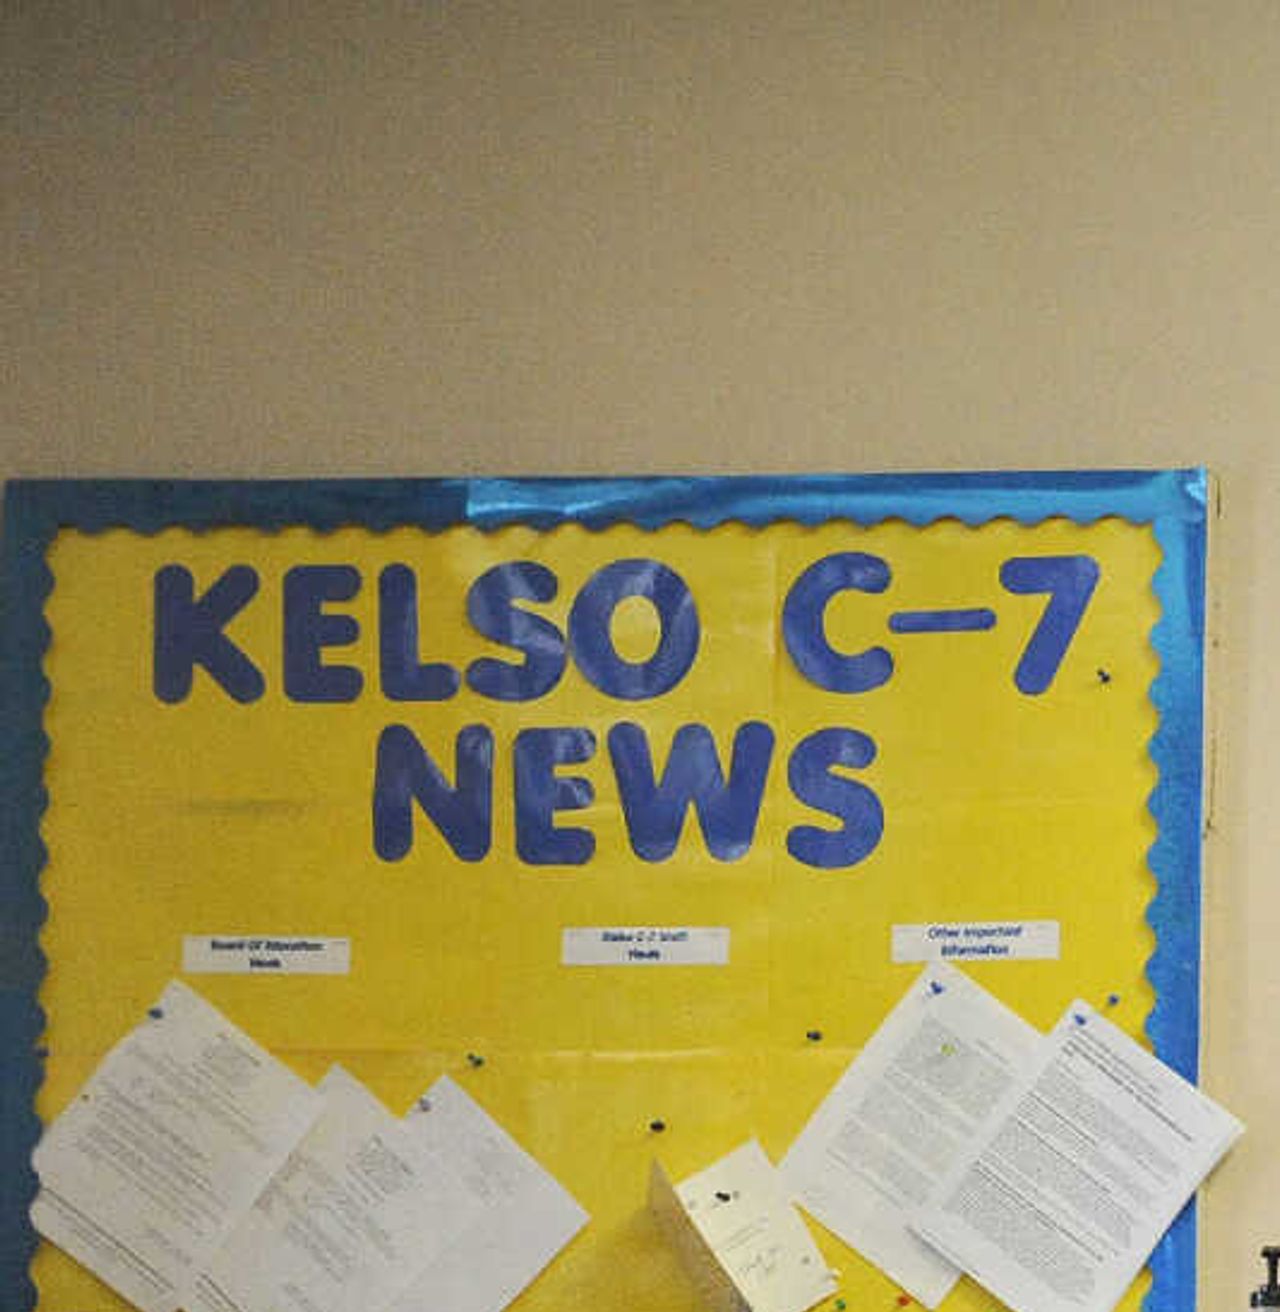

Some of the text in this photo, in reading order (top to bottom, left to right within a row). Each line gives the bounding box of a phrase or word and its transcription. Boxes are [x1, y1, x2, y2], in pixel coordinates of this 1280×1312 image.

[152, 551, 1101, 705] KELSO C-7
[371, 721, 886, 868] NEWS
